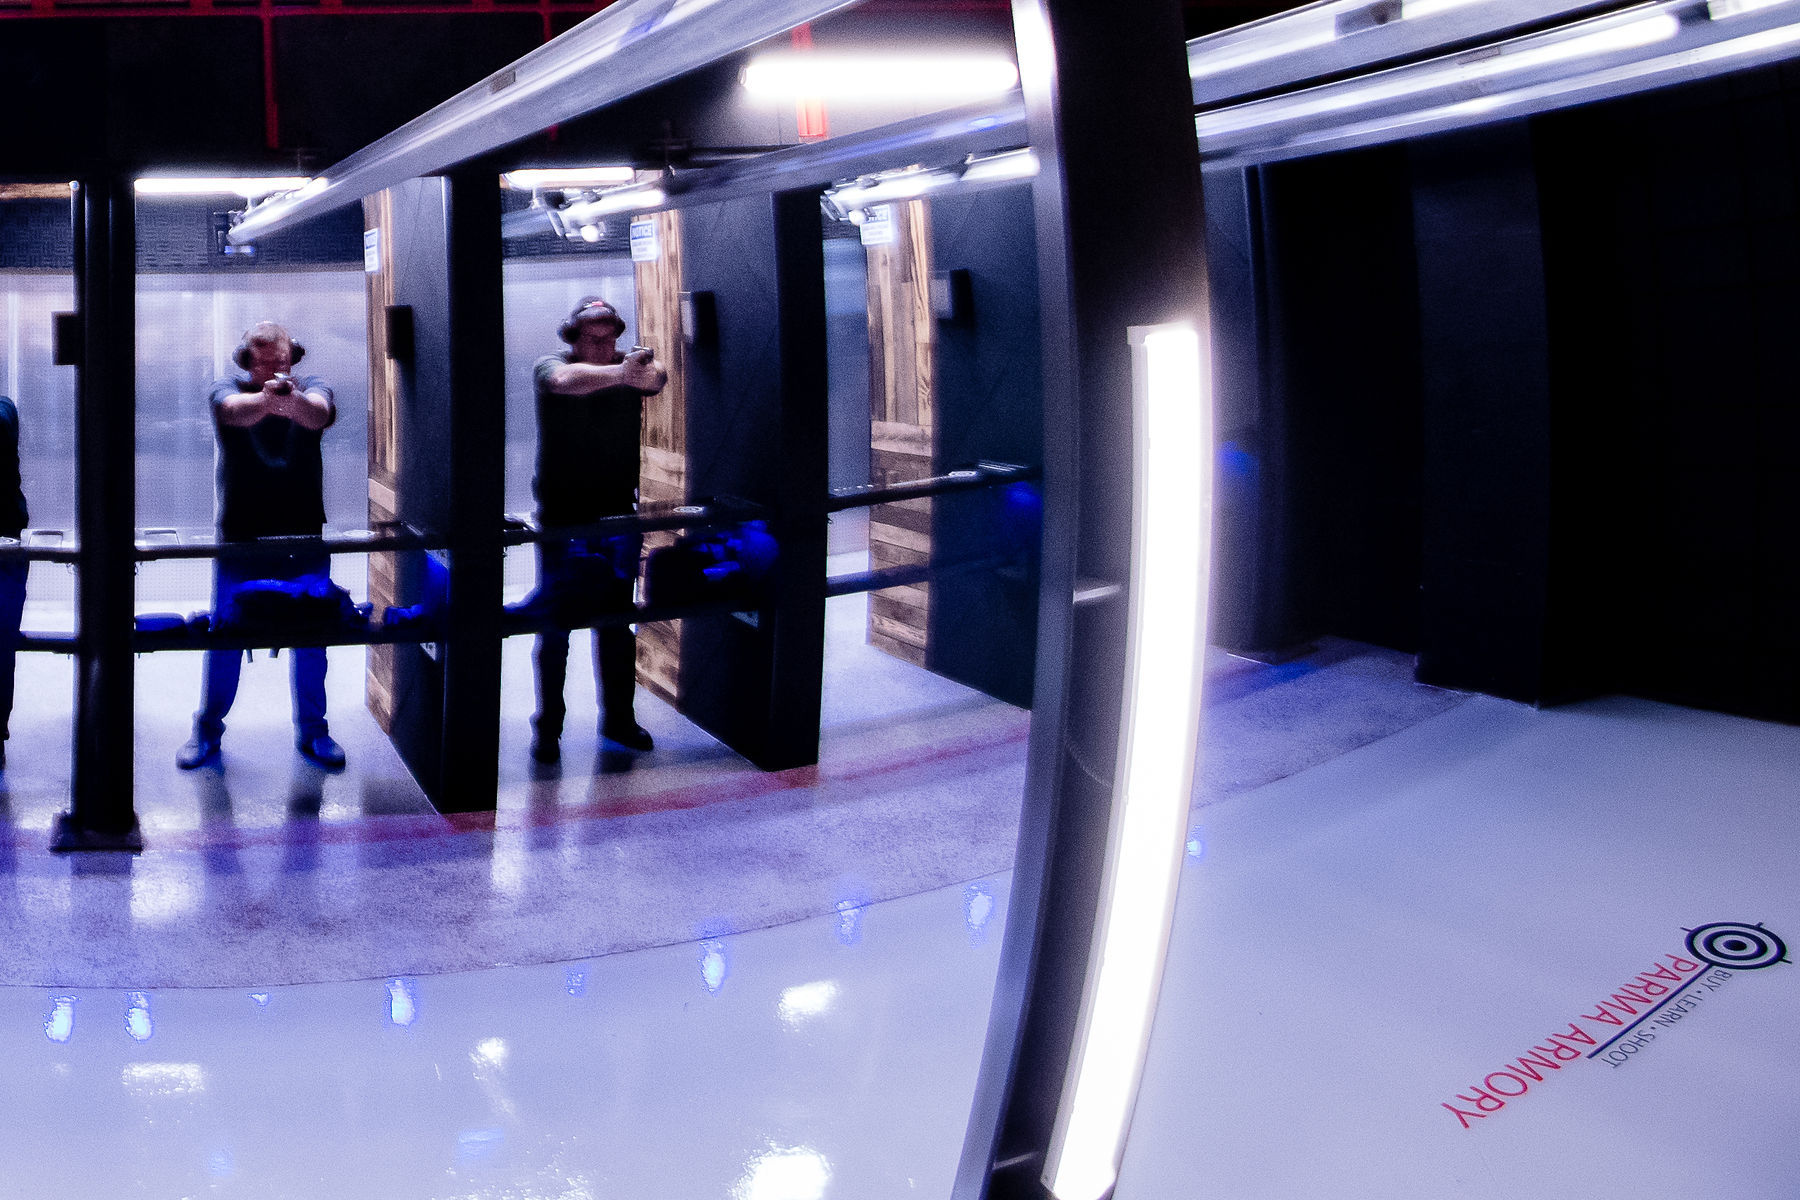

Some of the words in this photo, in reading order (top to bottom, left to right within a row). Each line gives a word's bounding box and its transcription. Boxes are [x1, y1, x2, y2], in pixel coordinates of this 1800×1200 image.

[1579, 953, 1699, 1026] PARMA
[1699, 968, 1733, 992] BUY
[1653, 994, 1702, 1028] LEARN
[1601, 1029, 1656, 1069] SHOOT
[1441, 1022, 1598, 1129] ARMORY
